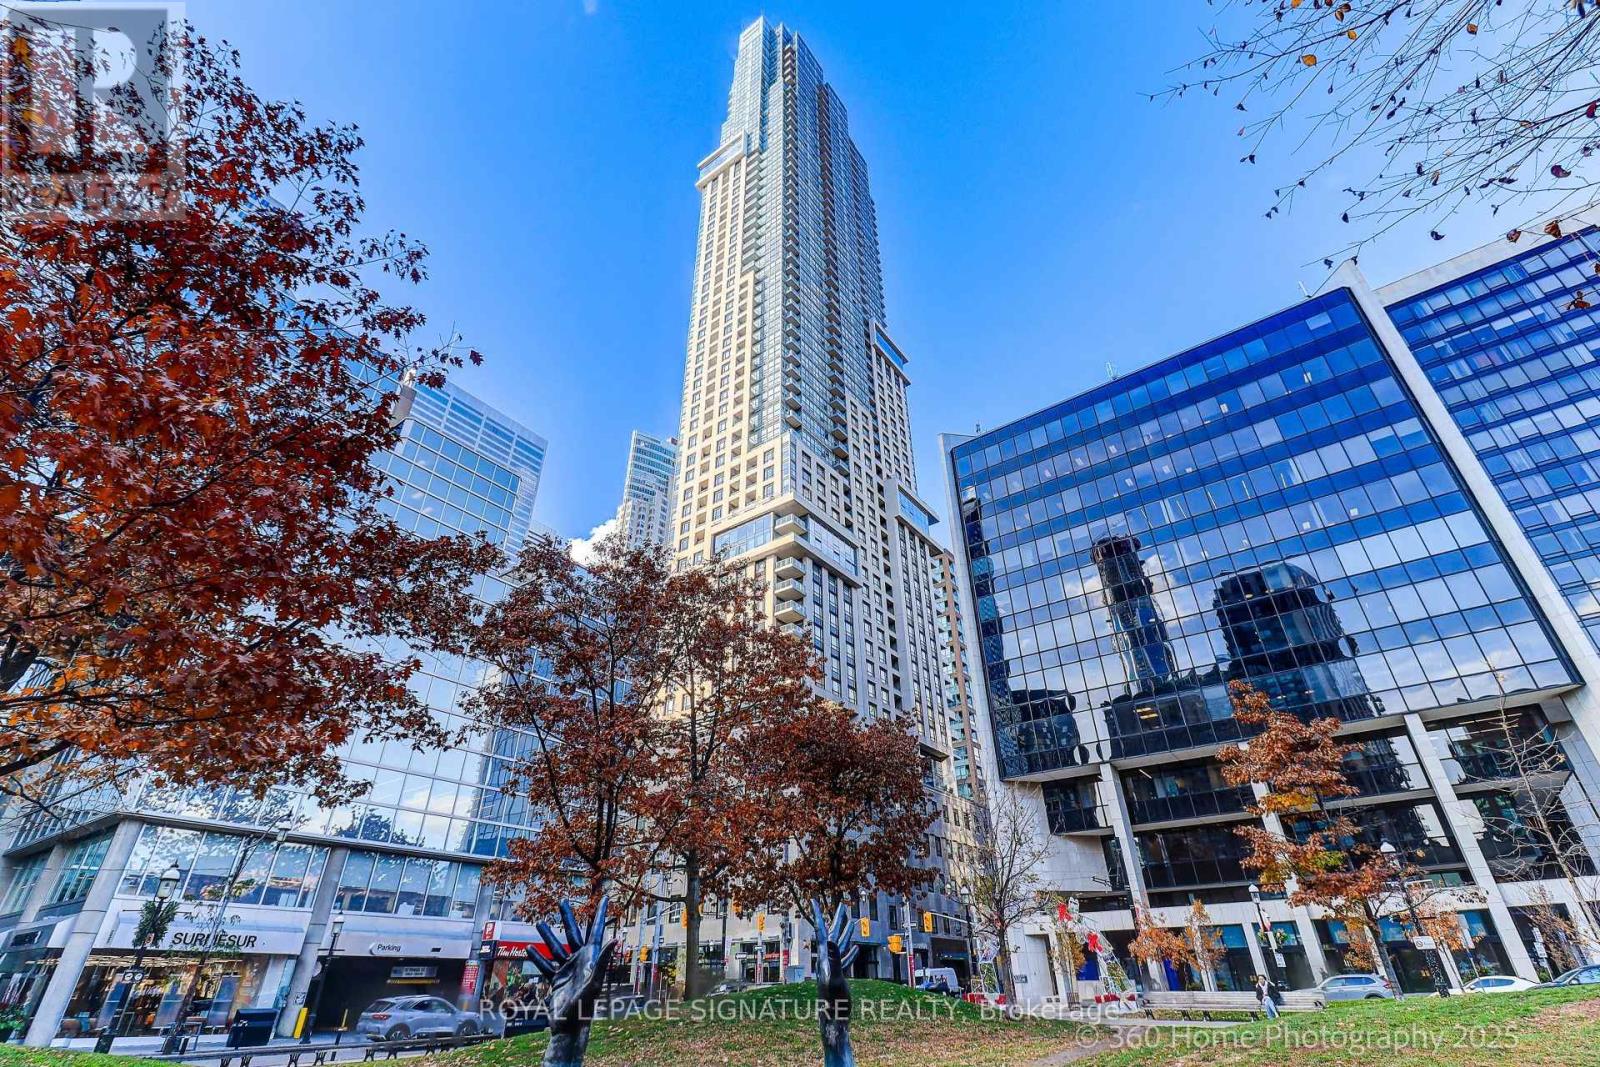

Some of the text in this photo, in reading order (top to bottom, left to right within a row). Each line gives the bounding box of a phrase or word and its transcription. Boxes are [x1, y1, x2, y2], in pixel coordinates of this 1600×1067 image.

[377, 944, 401, 953] Parking
[497, 945, 510, 957] Tim
[510, 945, 529, 957] Horto
